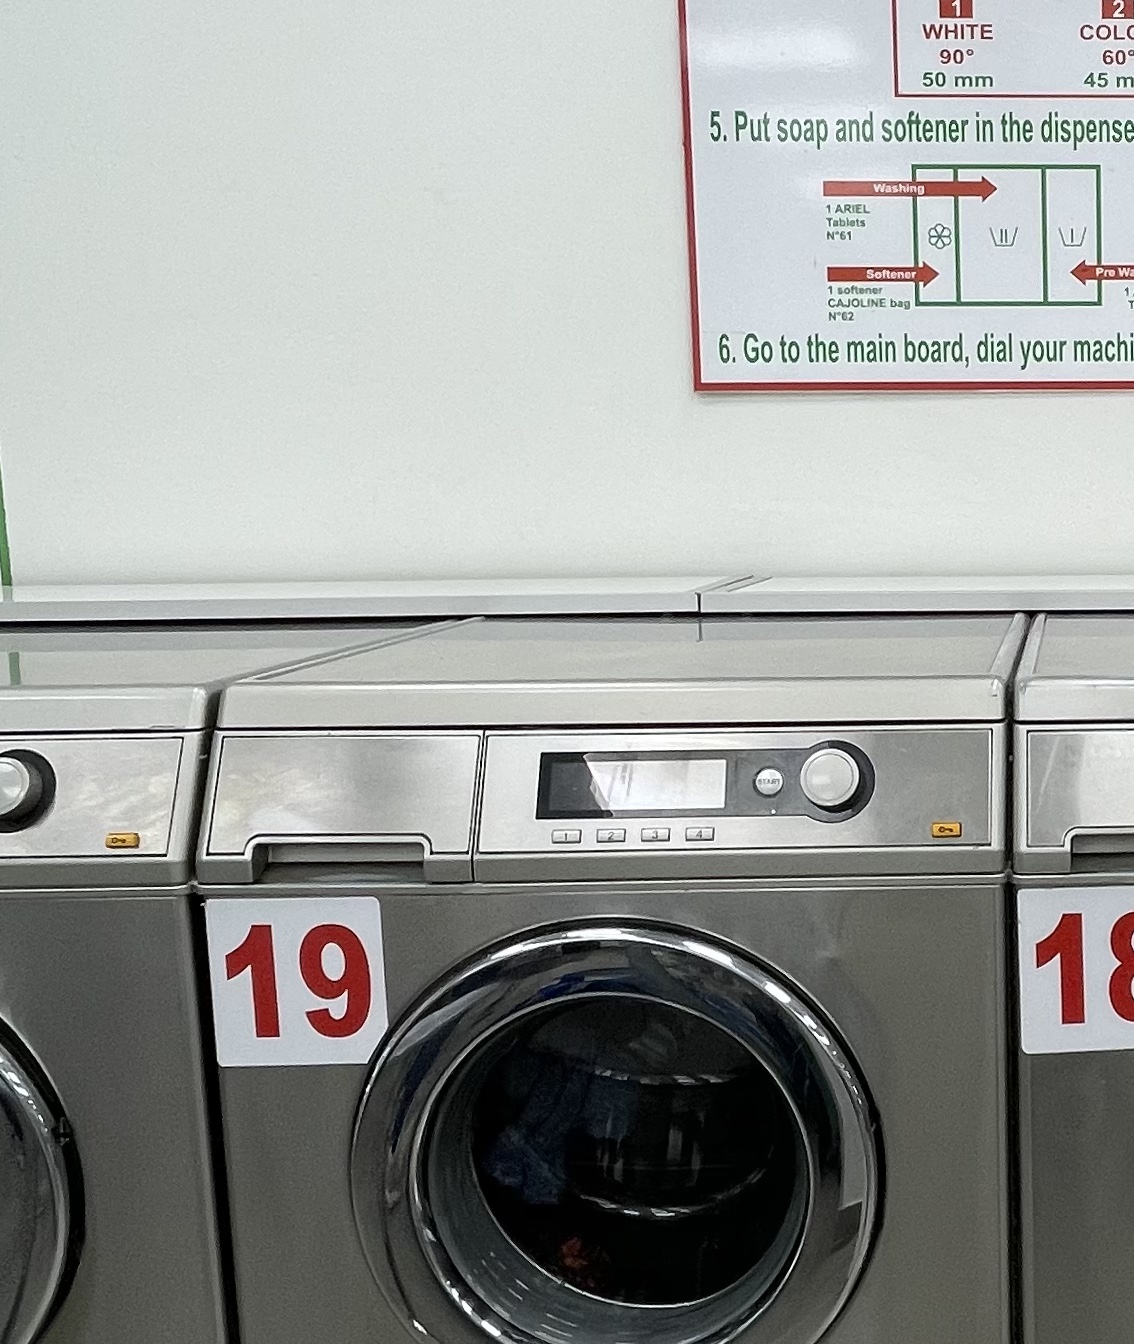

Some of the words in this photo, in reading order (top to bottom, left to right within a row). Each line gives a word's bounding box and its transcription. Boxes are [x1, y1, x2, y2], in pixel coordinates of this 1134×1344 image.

[1112, 0, 1125, 18] 2
[921, 23, 994, 40] WHITE
[922, 71, 947, 88] 50
[954, 75, 994, 88] mm
[1083, 71, 1109, 88] 45
[710, 111, 727, 141] 5.
[735, 111, 770, 142] Put
[777, 119, 828, 149] soap
[836, 111, 873, 142] and
[882, 111, 968, 142] softener
[976, 112, 993, 142] in
[1001, 112, 1033, 142] the
[873, 182, 926, 197] Washing
[826, 204, 831, 214] 1
[834, 203, 871, 214] ARIEL
[825, 217, 866, 228] Tablets
[865, 268, 917, 280] Softener
[1095, 267, 1116, 277] Pre
[827, 285, 833, 296] 1
[837, 284, 884, 295] softener
[1124, 286, 1130, 297] 1
[827, 297, 887, 309] CAJOLINE
[889, 297, 911, 311] bag
[719, 334, 735, 363] 6.
[744, 334, 773, 363] Go
[780, 335, 799, 362] to
[807, 334, 839, 362] the
[847, 333, 896, 362] main
[905, 333, 969, 368] board,
[977, 333, 1012, 362] dial
[1020, 341, 1067, 370] your
[225, 925, 370, 1038] 19
